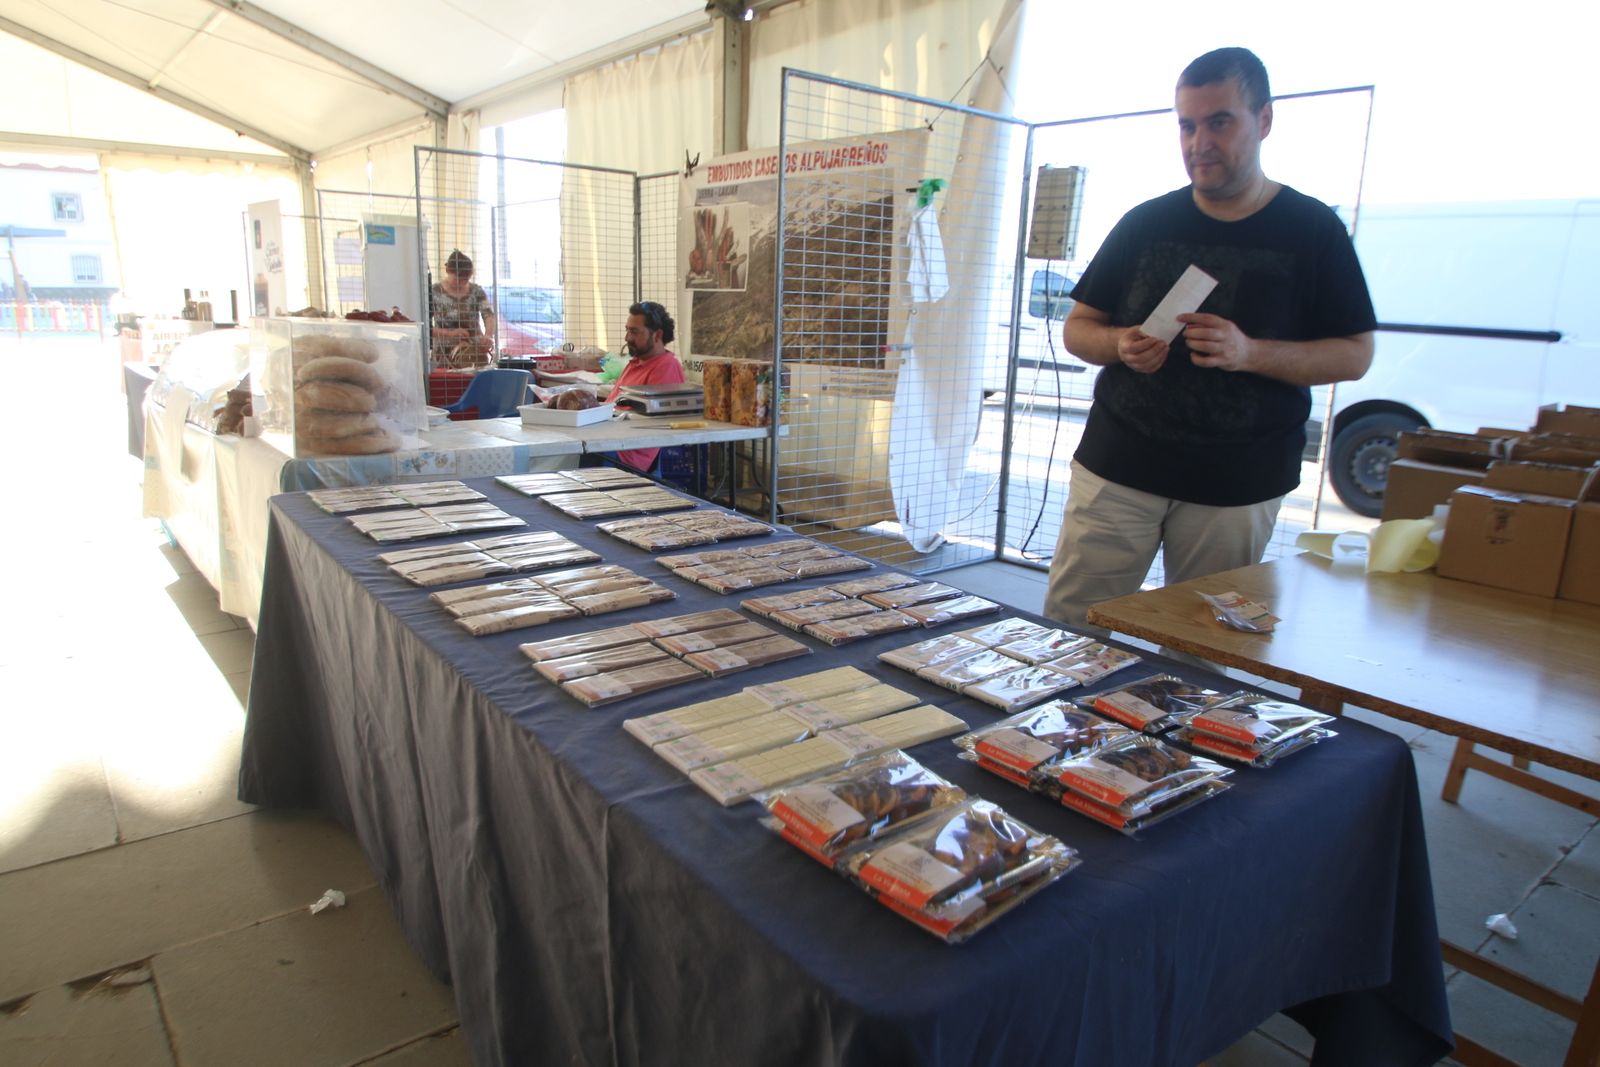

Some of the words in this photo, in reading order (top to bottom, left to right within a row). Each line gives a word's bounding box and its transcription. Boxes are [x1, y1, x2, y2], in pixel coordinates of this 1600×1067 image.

[707, 161, 753, 184] EMBUTIDOS
[755, 152, 798, 177] CASEOS
[800, 141, 889, 172] ALPUJARREÑOS
